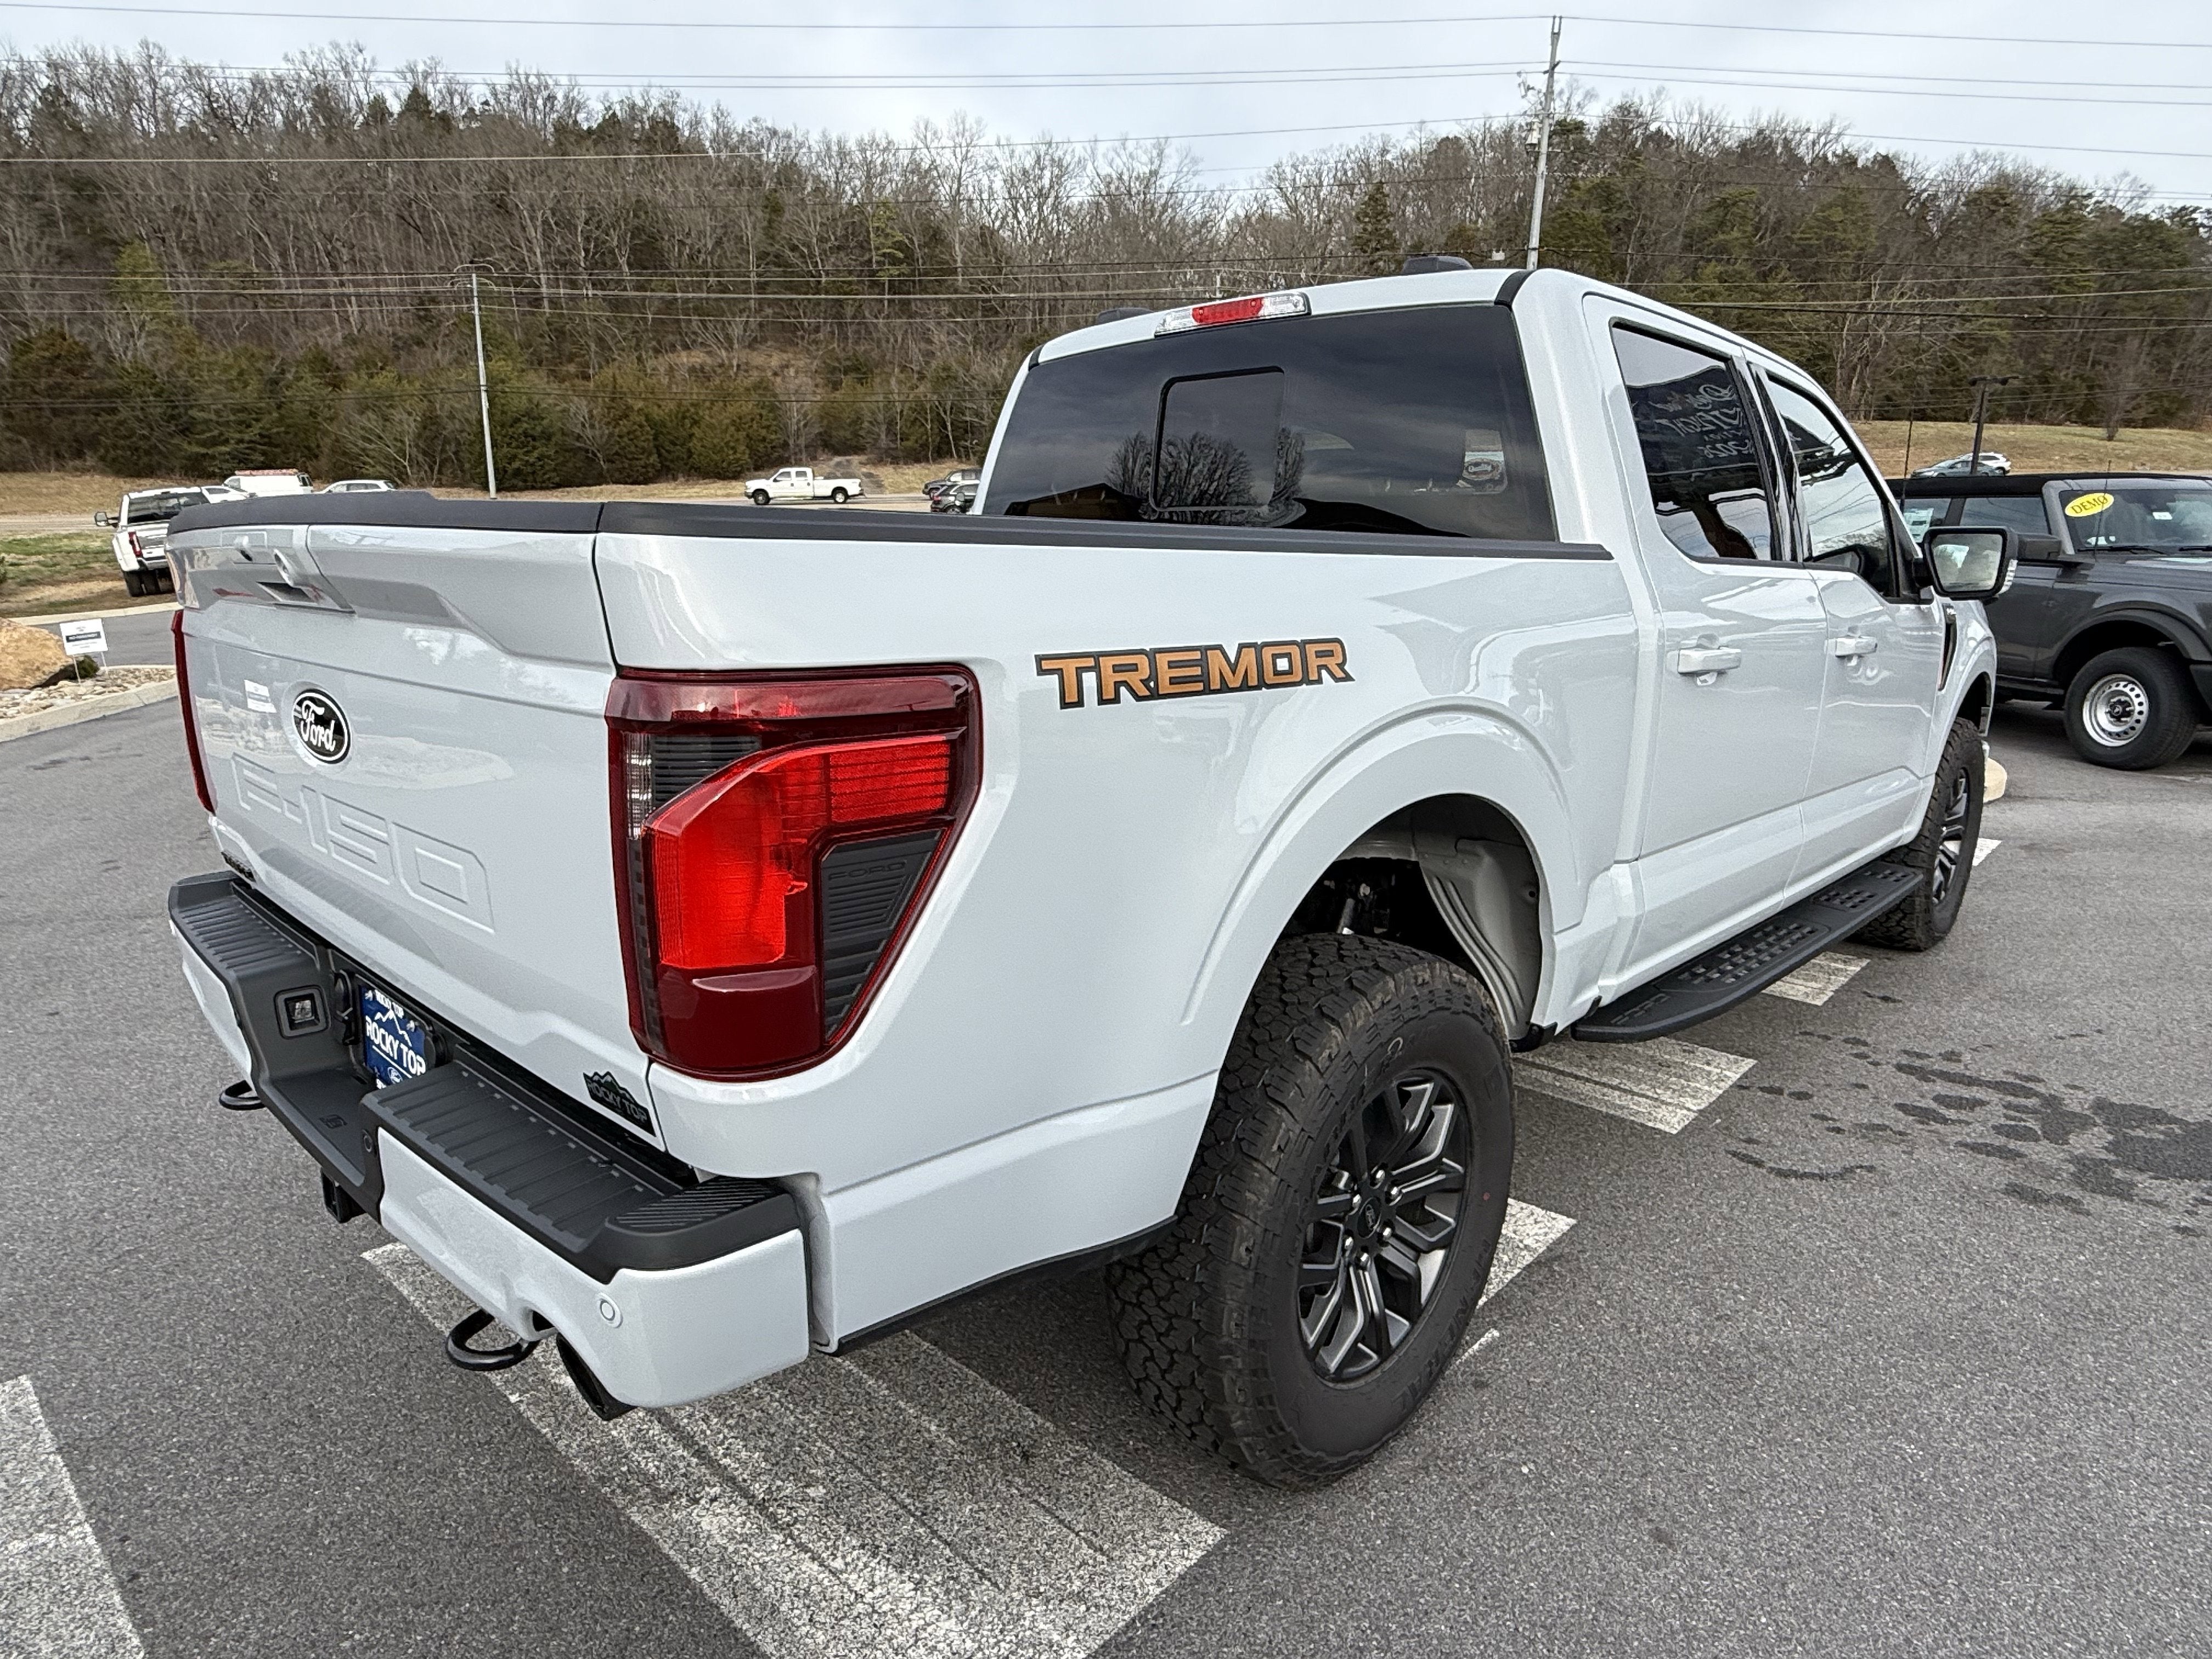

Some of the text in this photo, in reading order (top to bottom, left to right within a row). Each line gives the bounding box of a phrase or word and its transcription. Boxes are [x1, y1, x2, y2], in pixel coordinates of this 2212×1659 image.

[2070, 495, 2108, 514] DEMO
[1034, 637, 1356, 709] TREMOR
[300, 700, 336, 752] Ford
[828, 860, 907, 881] FORD
[365, 1015, 399, 1060] ROCKY
[400, 1044, 426, 1076] TOP
[586, 1080, 647, 1123] ROCKY TOP
